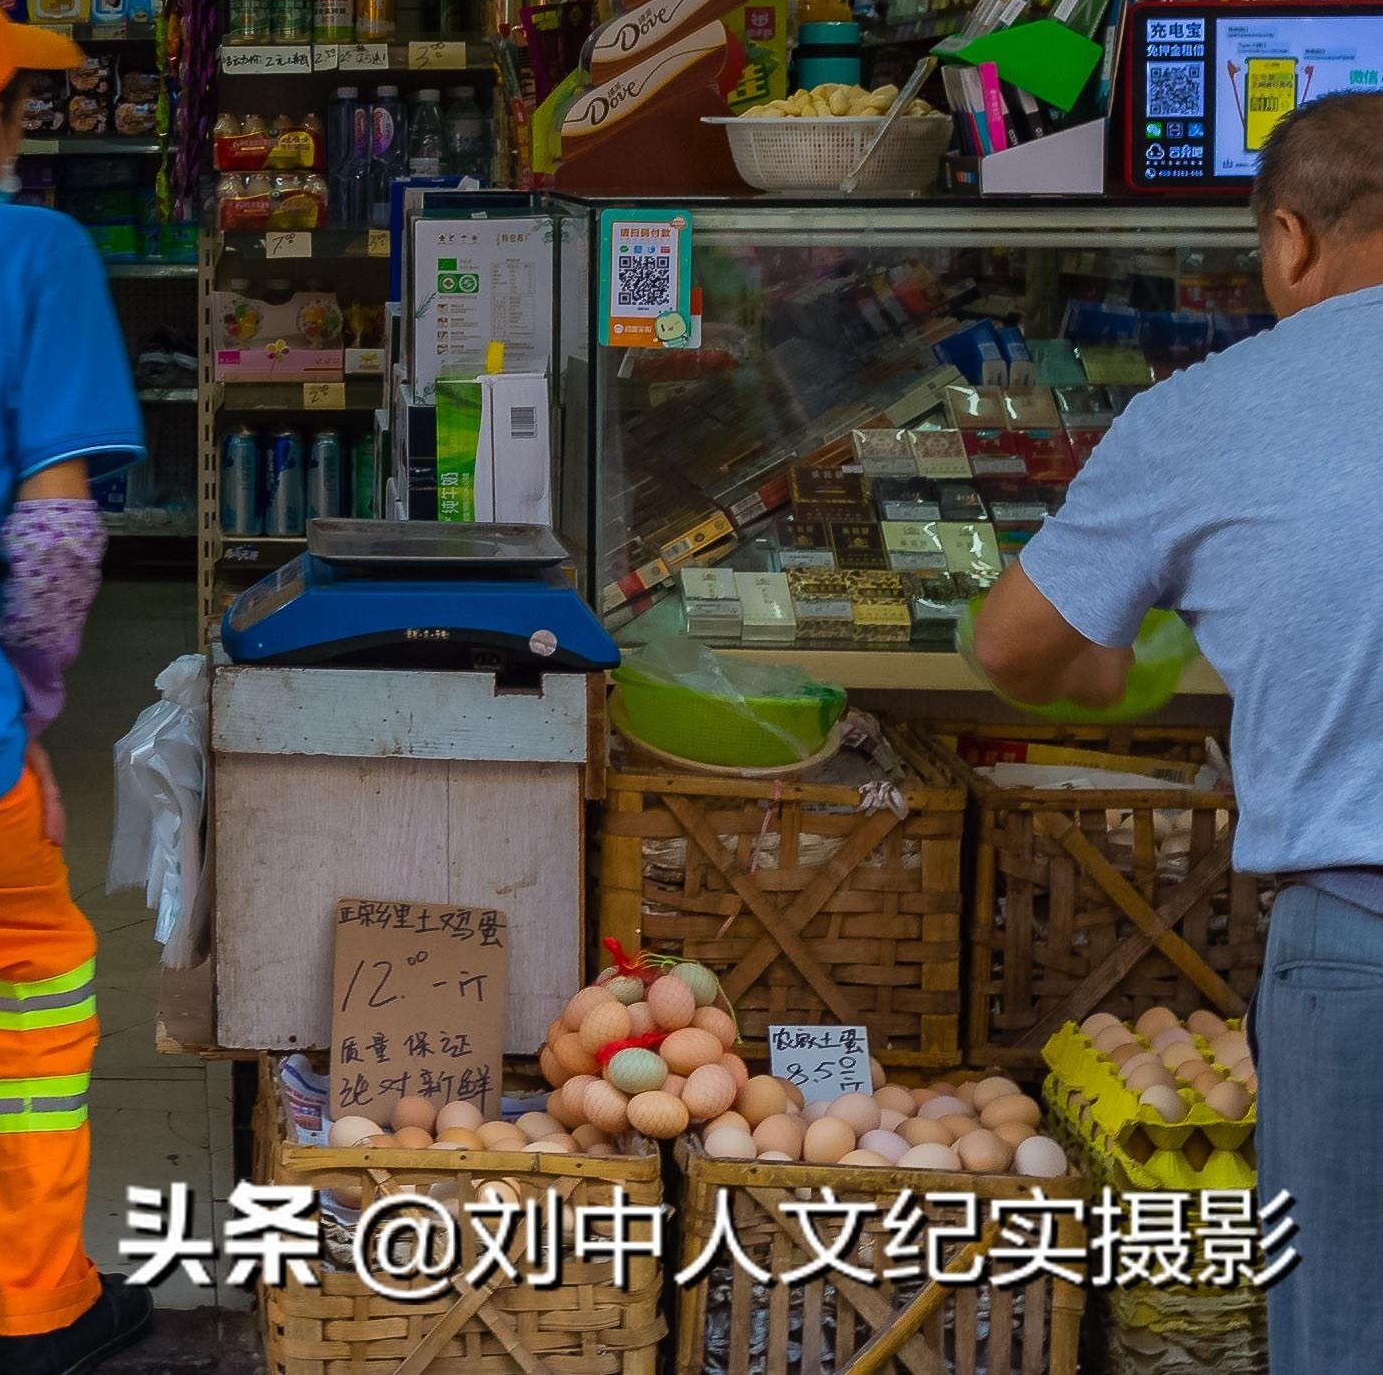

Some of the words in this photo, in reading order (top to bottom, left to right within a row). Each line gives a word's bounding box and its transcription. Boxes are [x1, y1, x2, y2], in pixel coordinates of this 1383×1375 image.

[619, 7, 673, 52] Dove
[1150, 22, 1202, 39] 充电宝
[589, 81, 643, 126] Dove
